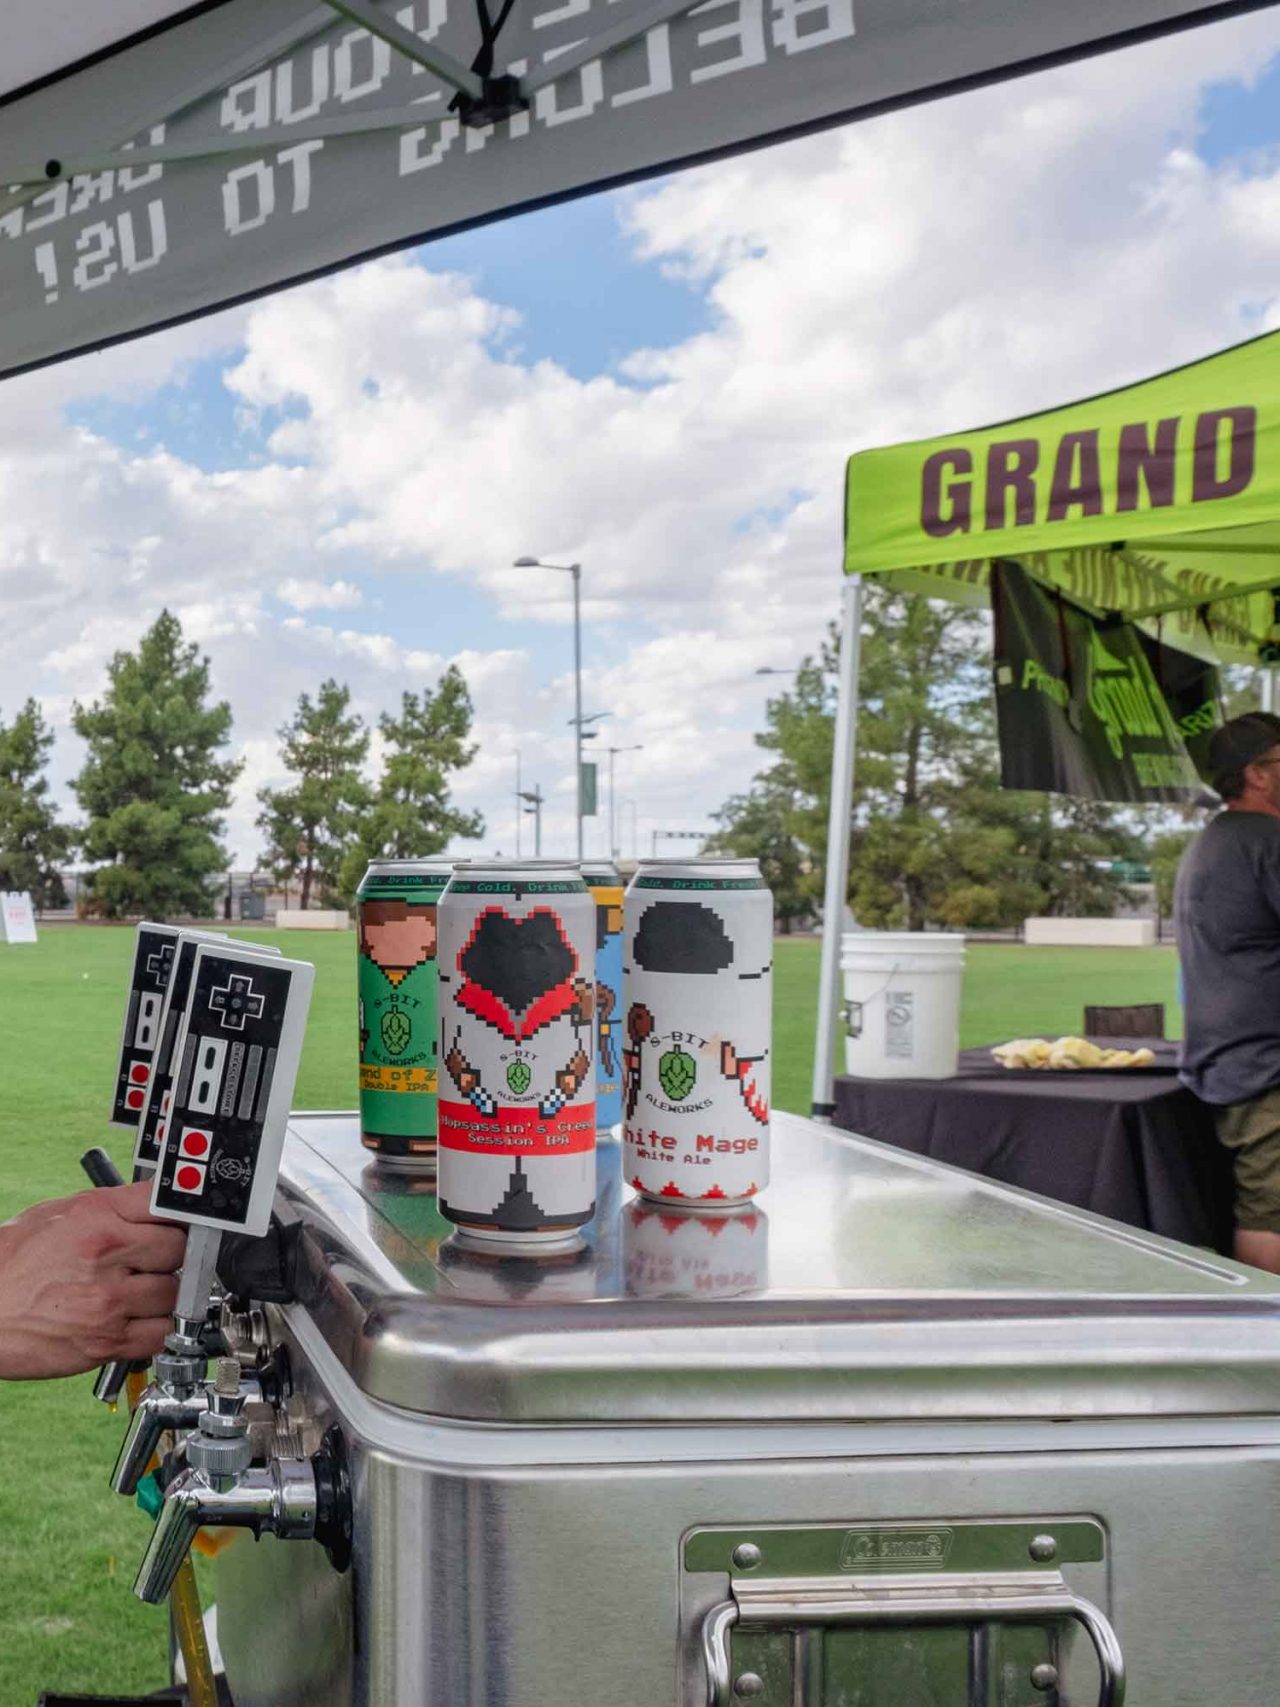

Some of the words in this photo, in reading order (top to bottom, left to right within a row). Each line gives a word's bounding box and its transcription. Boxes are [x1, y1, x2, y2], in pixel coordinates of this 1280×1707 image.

[920, 405, 1257, 537] GRAND
[650, 1031, 709, 1048] 8-BIT
[645, 1093, 713, 1114] ALEWORKS
[468, 1132, 534, 1146] Session
[545, 1135, 570, 1146] IPA
[623, 1125, 677, 1150] hite
[696, 1135, 758, 1155] Mage
[683, 1154, 712, 1165] Ale
